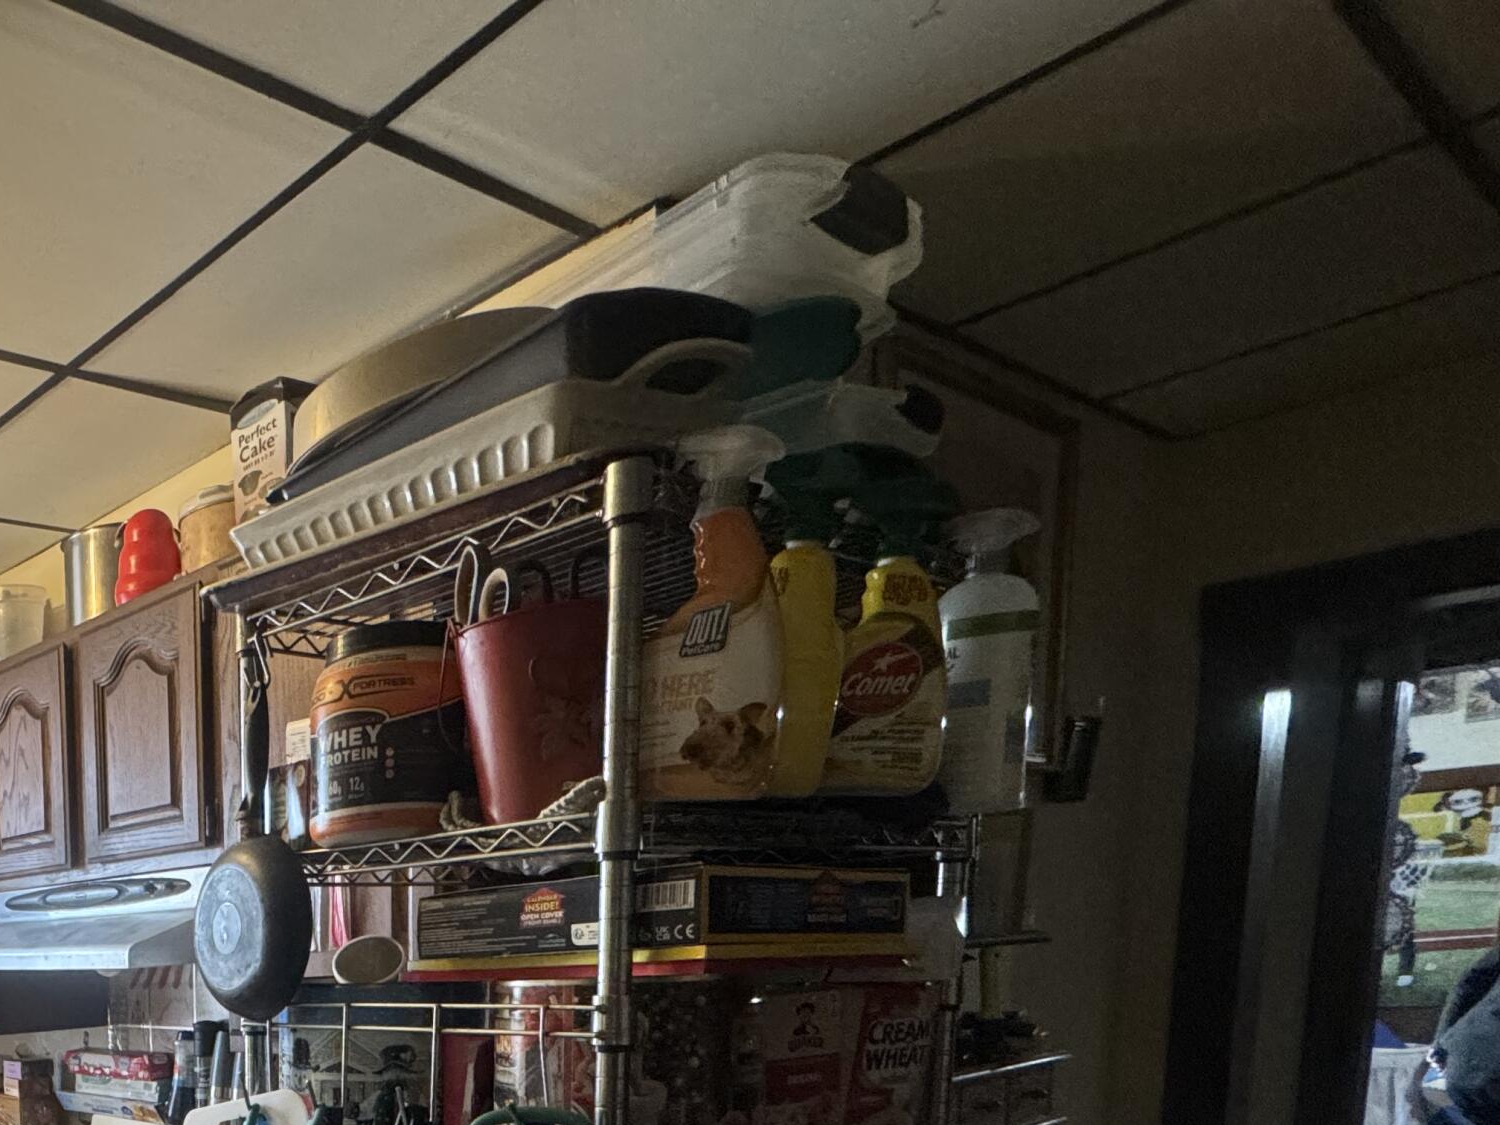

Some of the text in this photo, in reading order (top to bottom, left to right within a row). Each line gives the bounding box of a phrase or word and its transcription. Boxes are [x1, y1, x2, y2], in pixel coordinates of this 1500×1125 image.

[238, 418, 277, 448] Perfect
[239, 435, 276, 464] Cake
[685, 602, 731, 646] OUT!
[841, 672, 916, 698] Comet
[320, 724, 383, 751] WHEY
[525, 901, 559, 912] INSIDE!
[868, 1021, 933, 1045] CREAM
[866, 1045, 928, 1071] WHEAT
